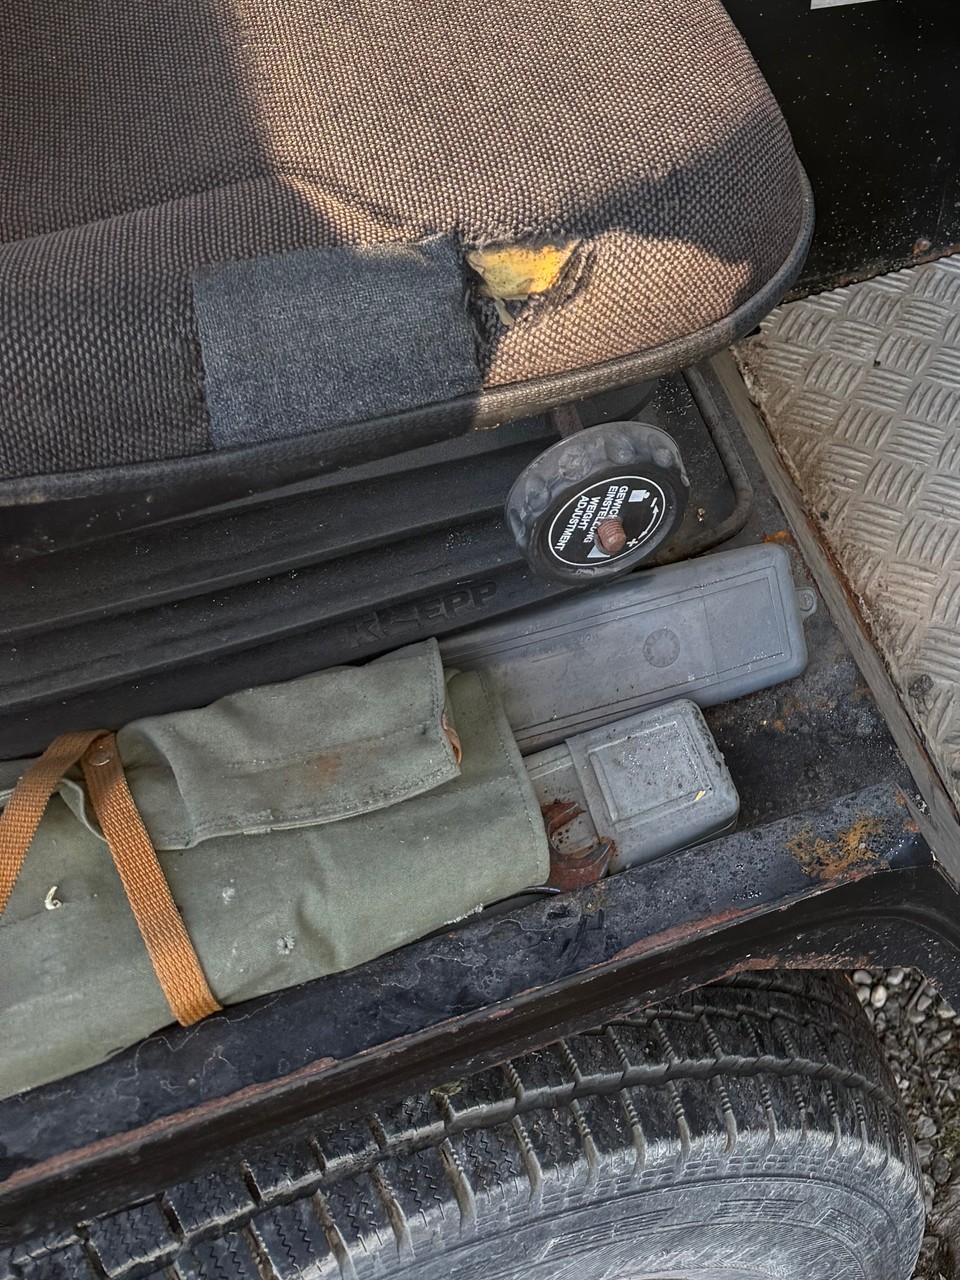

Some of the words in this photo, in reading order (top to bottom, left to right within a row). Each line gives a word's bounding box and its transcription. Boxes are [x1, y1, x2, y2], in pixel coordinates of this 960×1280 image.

[578, 496, 600, 530] WEIGHT
[608, 485, 628, 519] GEWICH
[554, 495, 585, 551] ADJUSTMENT
